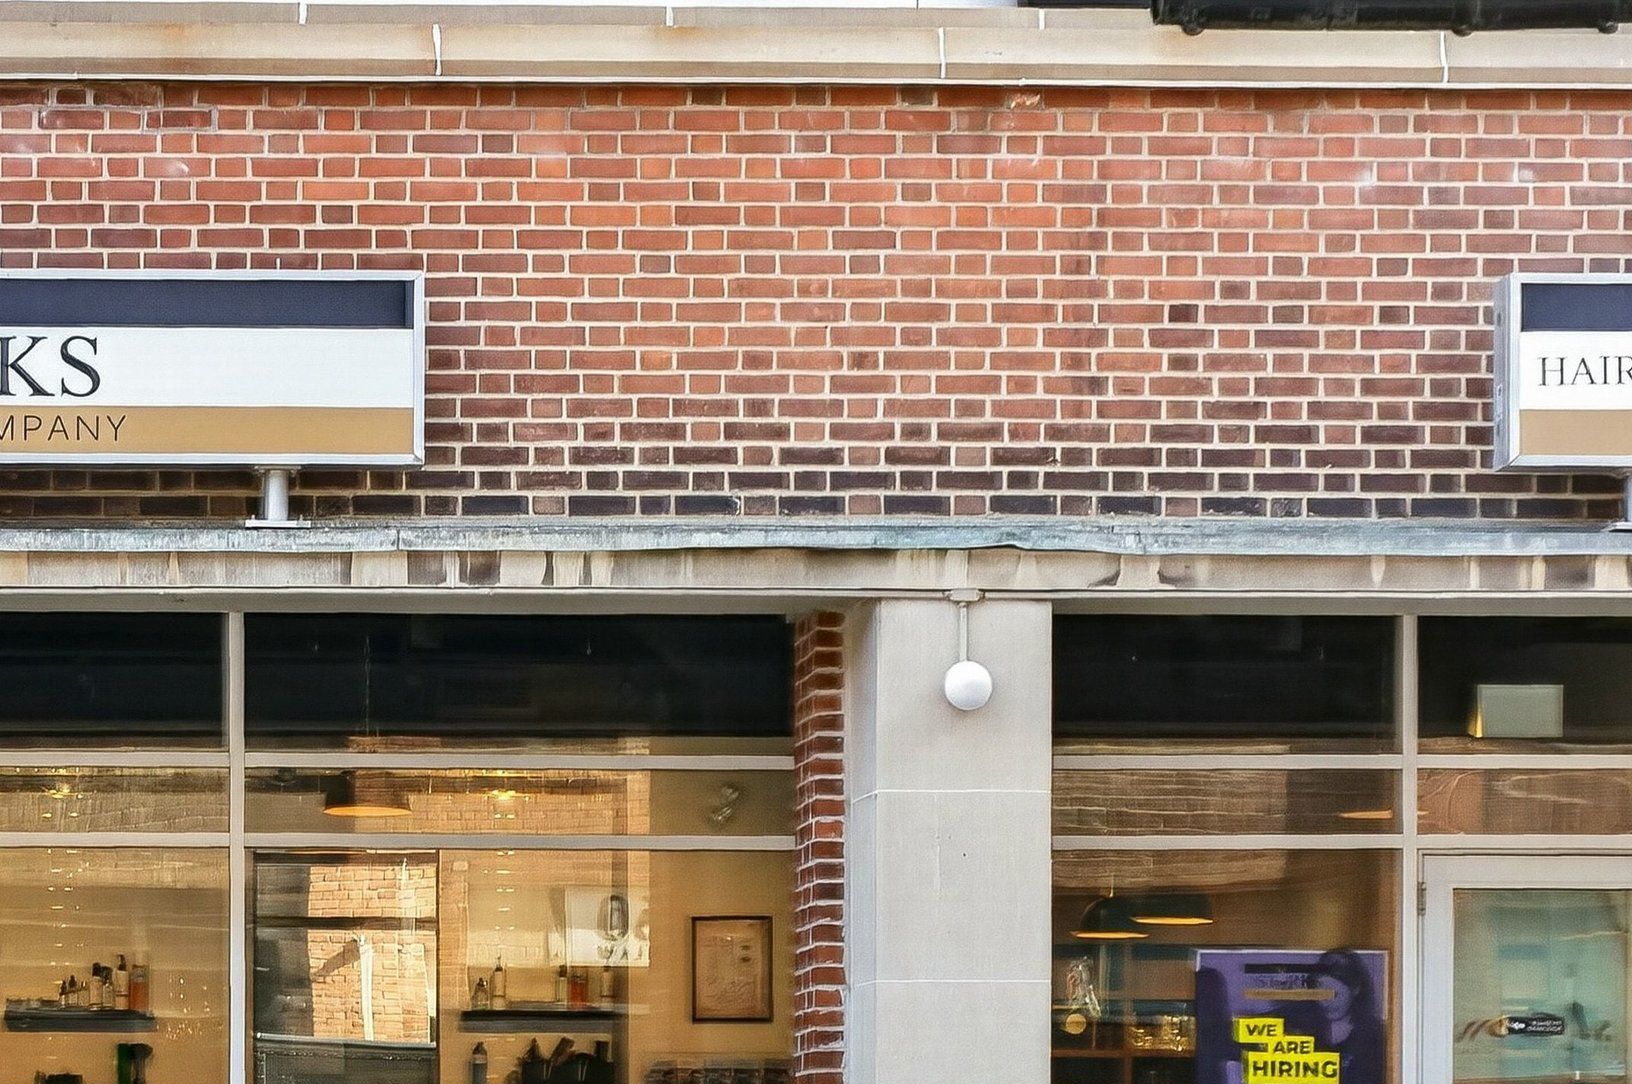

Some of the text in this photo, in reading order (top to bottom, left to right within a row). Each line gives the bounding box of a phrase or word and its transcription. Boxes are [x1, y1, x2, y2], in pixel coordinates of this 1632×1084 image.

[1538, 354, 1632, 387] HAIR
[1246, 1024, 1277, 1037] WE
[1273, 1041, 1312, 1055] ARE
[1252, 1060, 1339, 1079] HIRING
